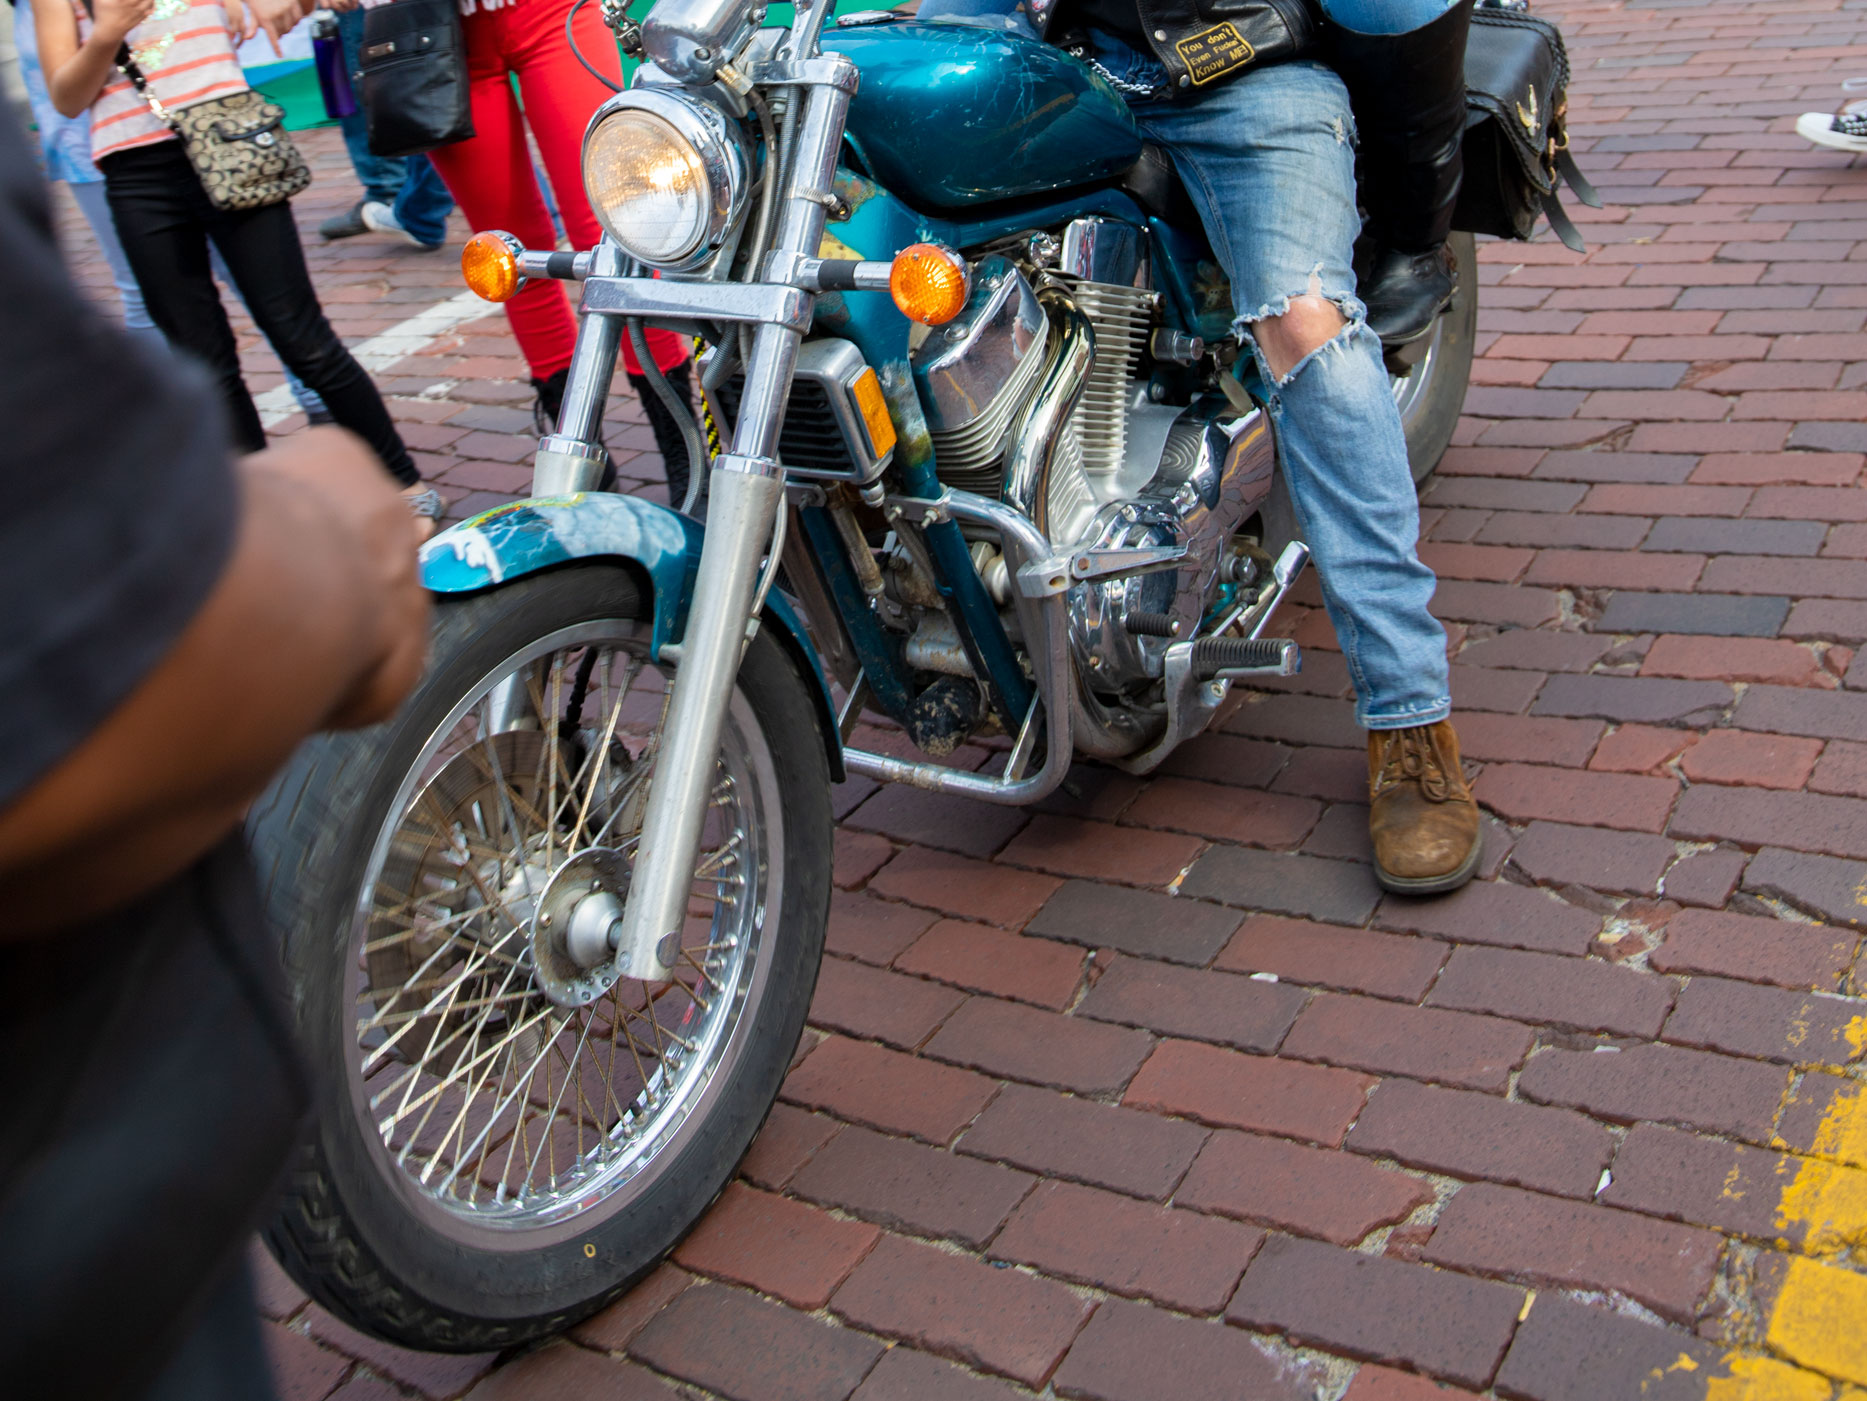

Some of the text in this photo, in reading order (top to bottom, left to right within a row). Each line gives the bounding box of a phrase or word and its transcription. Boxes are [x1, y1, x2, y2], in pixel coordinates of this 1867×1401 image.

[1181, 27, 1233, 55] You don't
[1190, 52, 1211, 66] Even
[1195, 58, 1225, 78] Know
